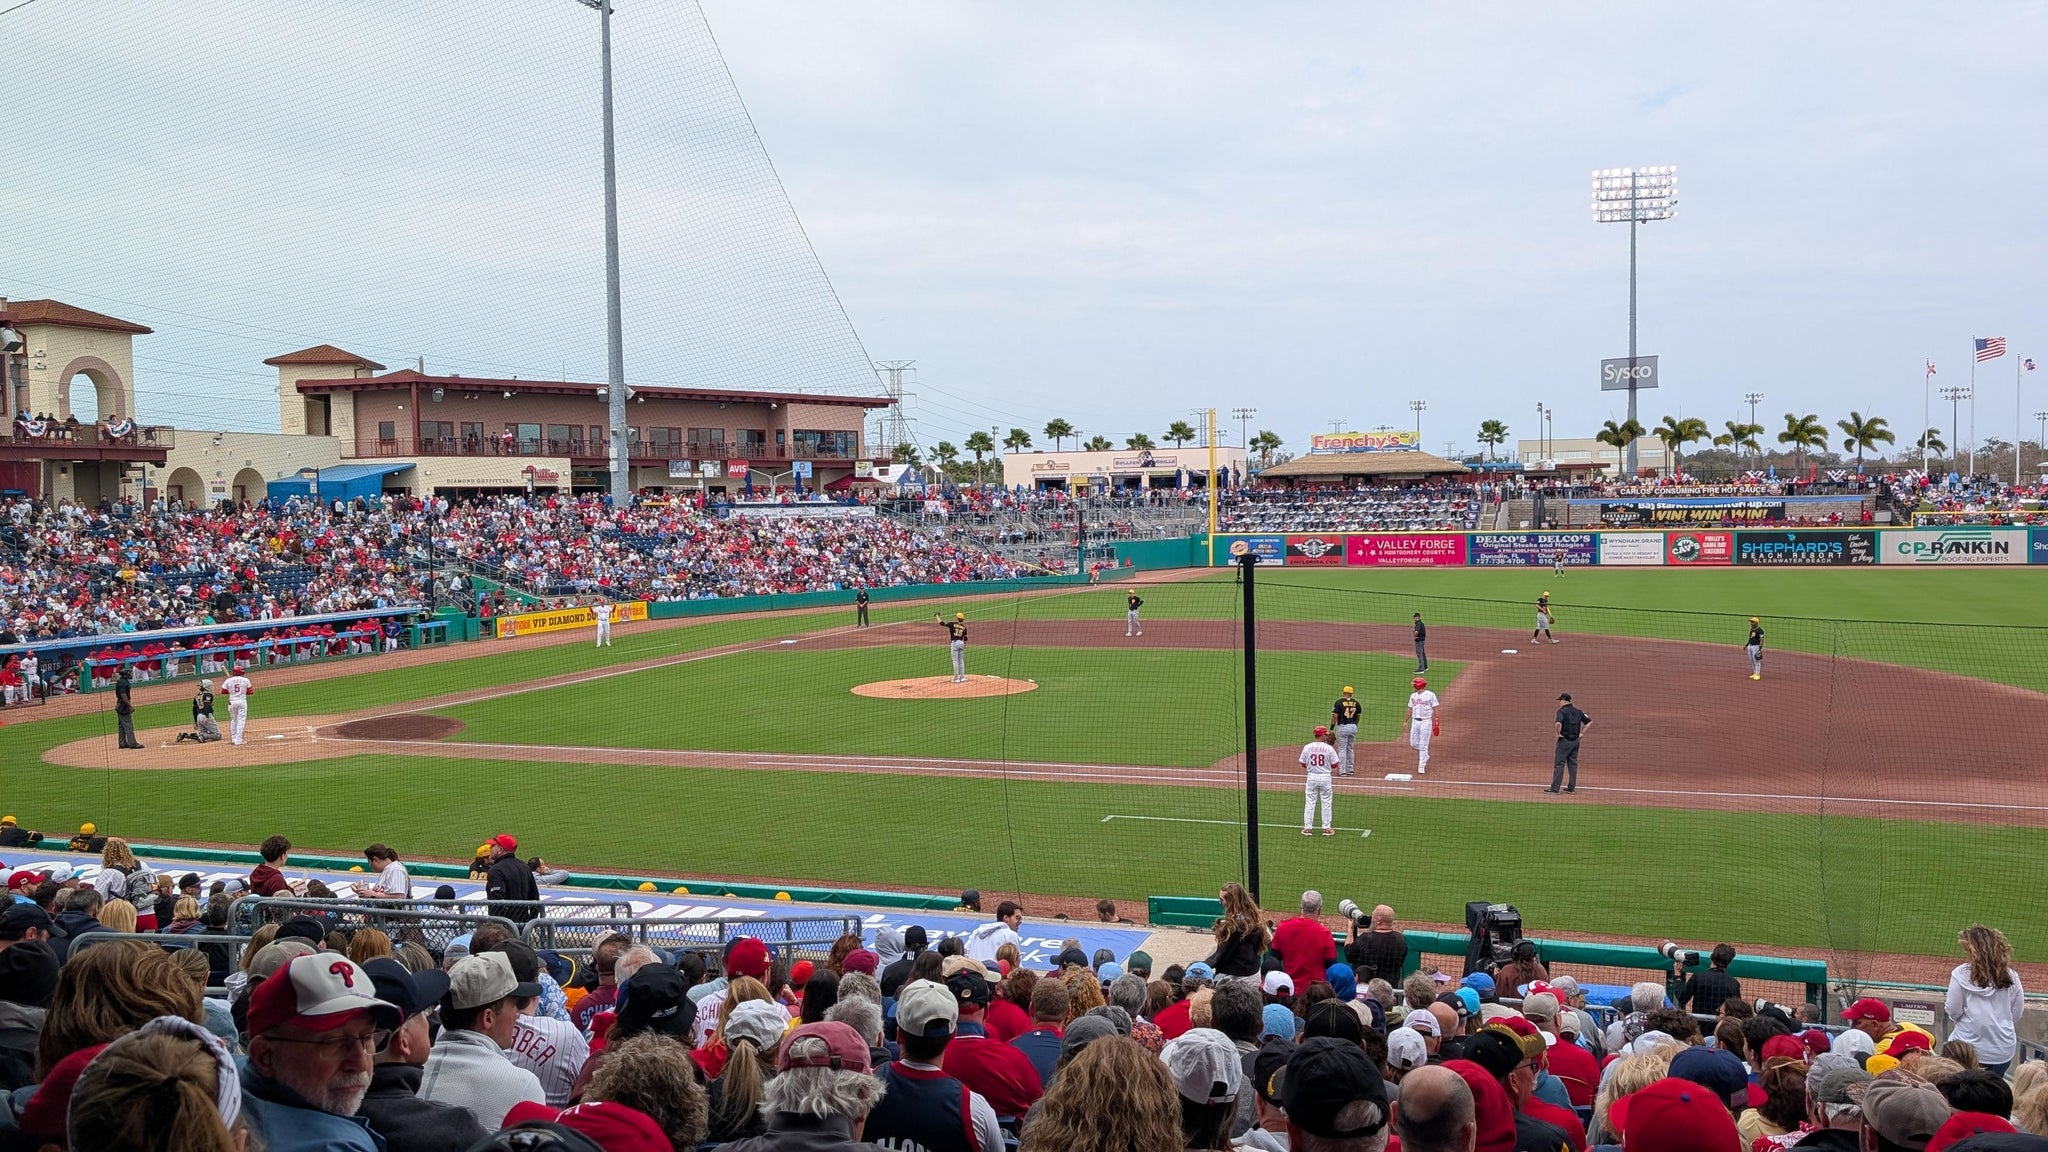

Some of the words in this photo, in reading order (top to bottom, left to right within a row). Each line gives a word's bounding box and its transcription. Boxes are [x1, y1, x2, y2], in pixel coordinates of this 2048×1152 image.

[1604, 364, 1652, 383] Sysco
[1314, 434, 1400, 449] Frenchy's
[526, 465, 559, 480] Phillies
[729, 465, 747, 473] AVIS
[1654, 487, 1700, 495] CONSUMING
[1376, 540, 1417, 549] VALLEY
[1420, 540, 1455, 548] FORGE
[1538, 535, 1590, 543] DELCO'S
[1742, 543, 1843, 553] SHEPHARD'S
[533, 618, 546, 627] VIP
[549, 612, 585, 626] DIAMOND
[234, 684, 240, 692] 5
[1344, 708, 1357, 719] 47
[1310, 754, 1325, 766] 38
[329, 961, 354, 988] P
